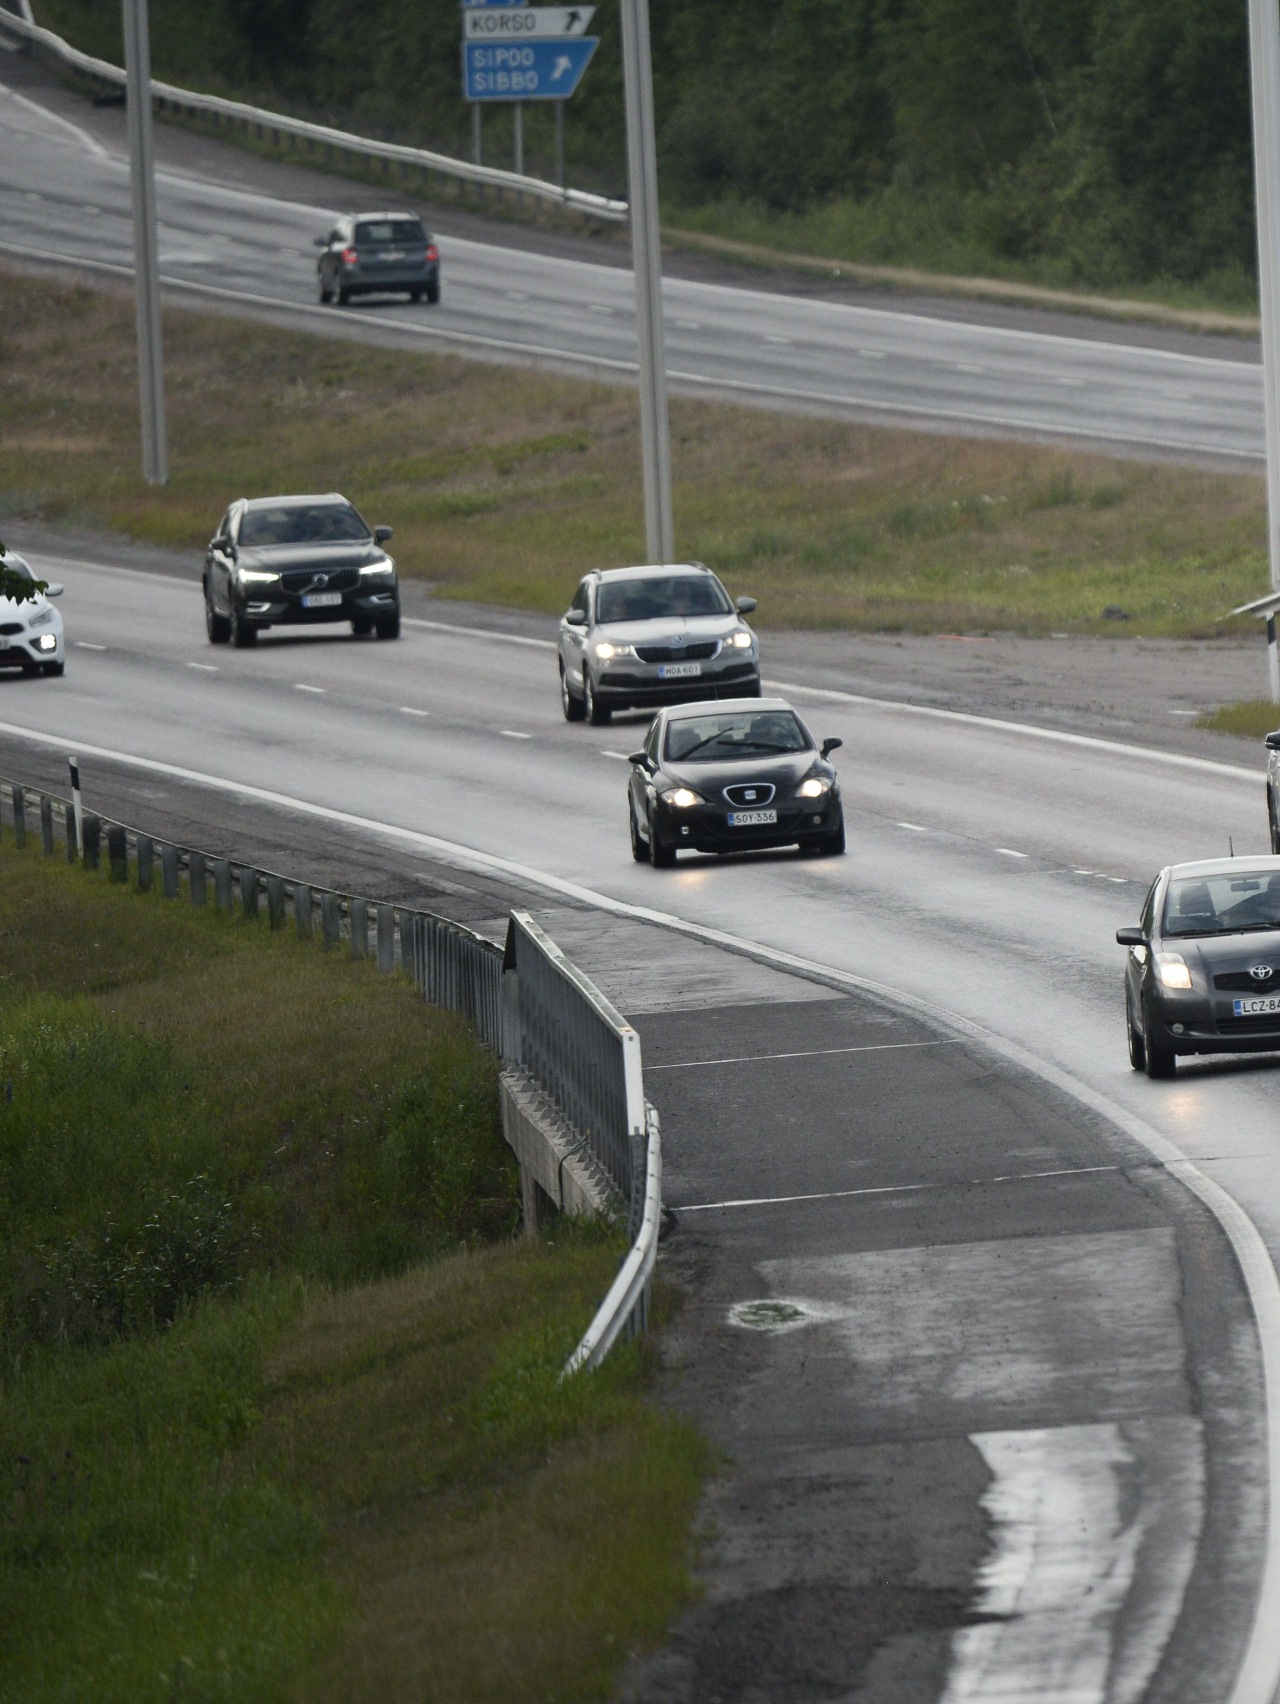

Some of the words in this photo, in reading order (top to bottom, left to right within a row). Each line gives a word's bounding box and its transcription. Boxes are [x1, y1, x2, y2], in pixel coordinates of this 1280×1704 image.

[472, 13, 536, 32] KORSO
[473, 48, 535, 68] SIPOO
[474, 70, 539, 91] SIBBO
[735, 812, 775, 824] SOY-336
